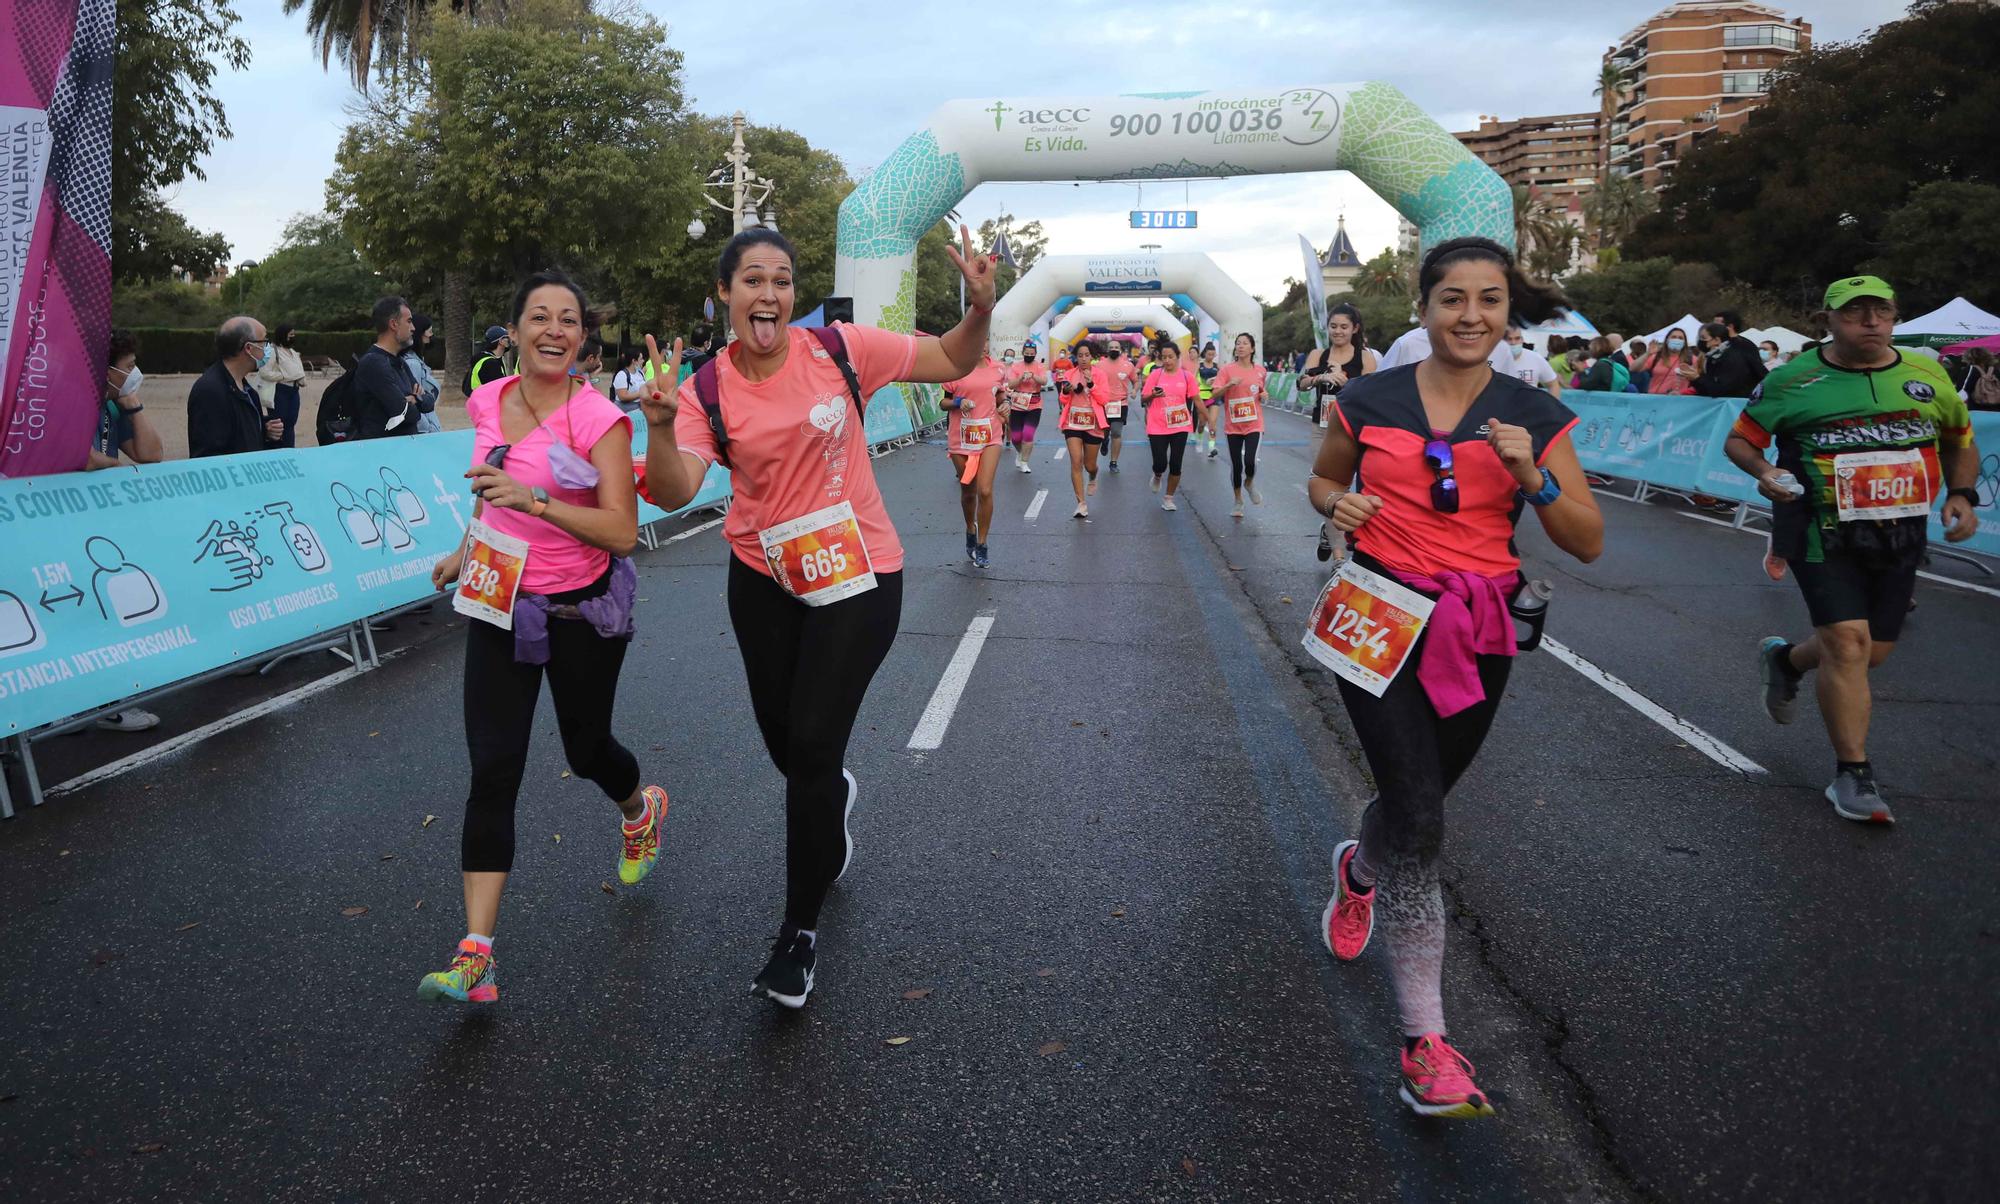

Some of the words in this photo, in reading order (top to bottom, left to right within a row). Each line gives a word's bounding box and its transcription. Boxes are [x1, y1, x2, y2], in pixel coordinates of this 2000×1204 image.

[1198, 98, 1285, 112] infocáncer
[1291, 91, 1312, 102] 24
[1018, 107, 1091, 124] aecc
[1110, 112, 1162, 137] 900
[1172, 110, 1222, 135] 100
[1229, 107, 1283, 132] 036
[1310, 110, 1325, 129] 7
[1025, 137, 1042, 152] Es
[1046, 136, 1088, 152] Vida.
[12, 121, 29, 226] VALENCIA
[1088, 267, 1158, 278] VALENCIA
[28, 398, 46, 441] con
[818, 406, 845, 427] aecc
[969, 431, 987, 442] 1143
[15, 485, 89, 520] COVID
[88, 482, 122, 510] DE
[121, 467, 228, 504] SEGURIDAD
[231, 463, 244, 488] E
[244, 458, 305, 485] HIGIENE
[1867, 475, 1915, 501] 1501
[32, 561, 73, 589] 1,5M
[801, 542, 848, 582] 665
[356, 568, 391, 592] EVITAR
[463, 559, 500, 597] 838
[228, 605, 257, 629] USO
[256, 600, 276, 622] DE
[273, 582, 338, 616] HIDROGELES
[1326, 603, 1391, 659] 1254
[71, 624, 197, 675] INTERPERSONAL
